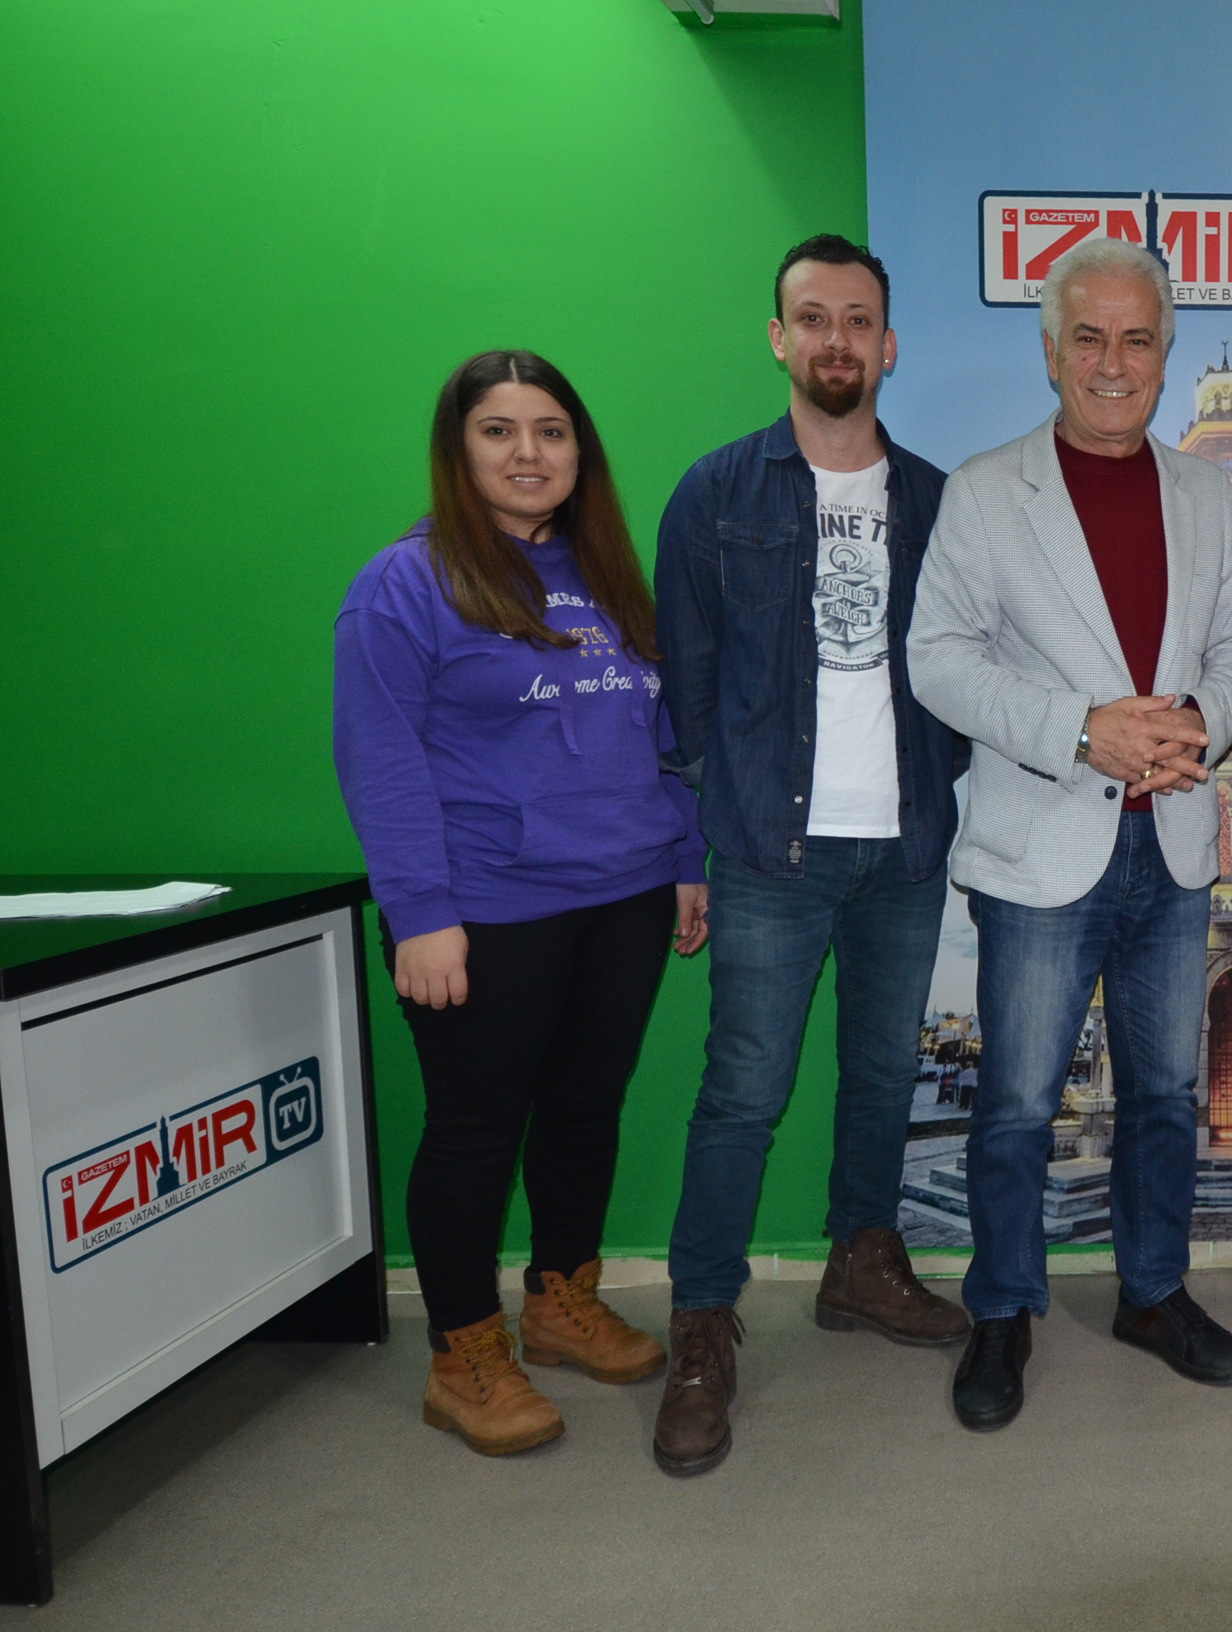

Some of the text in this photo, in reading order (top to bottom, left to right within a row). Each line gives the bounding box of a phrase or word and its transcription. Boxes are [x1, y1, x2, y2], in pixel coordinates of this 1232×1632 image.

[1029, 211, 1095, 223] GAZETEM
[1171, 287, 1195, 301] LET
[1198, 288, 1218, 301] VE
[828, 503, 855, 514] TIME
[856, 506, 868, 515] IN
[869, 508, 886, 519] OC
[818, 512, 863, 540] INE
[821, 578, 871, 605] ANCHORS
[823, 660, 875, 670] NAVIGATOR
[279, 1097, 307, 1130] TV
[80, 1153, 128, 1181] GAZETEM
[82, 1222, 123, 1251] İLKEMİZ
[129, 1203, 164, 1227] VATAN,
[165, 1184, 197, 1210] MİLLET
[198, 1178, 212, 1193] VE
[212, 1160, 248, 1186] BAYRAK
